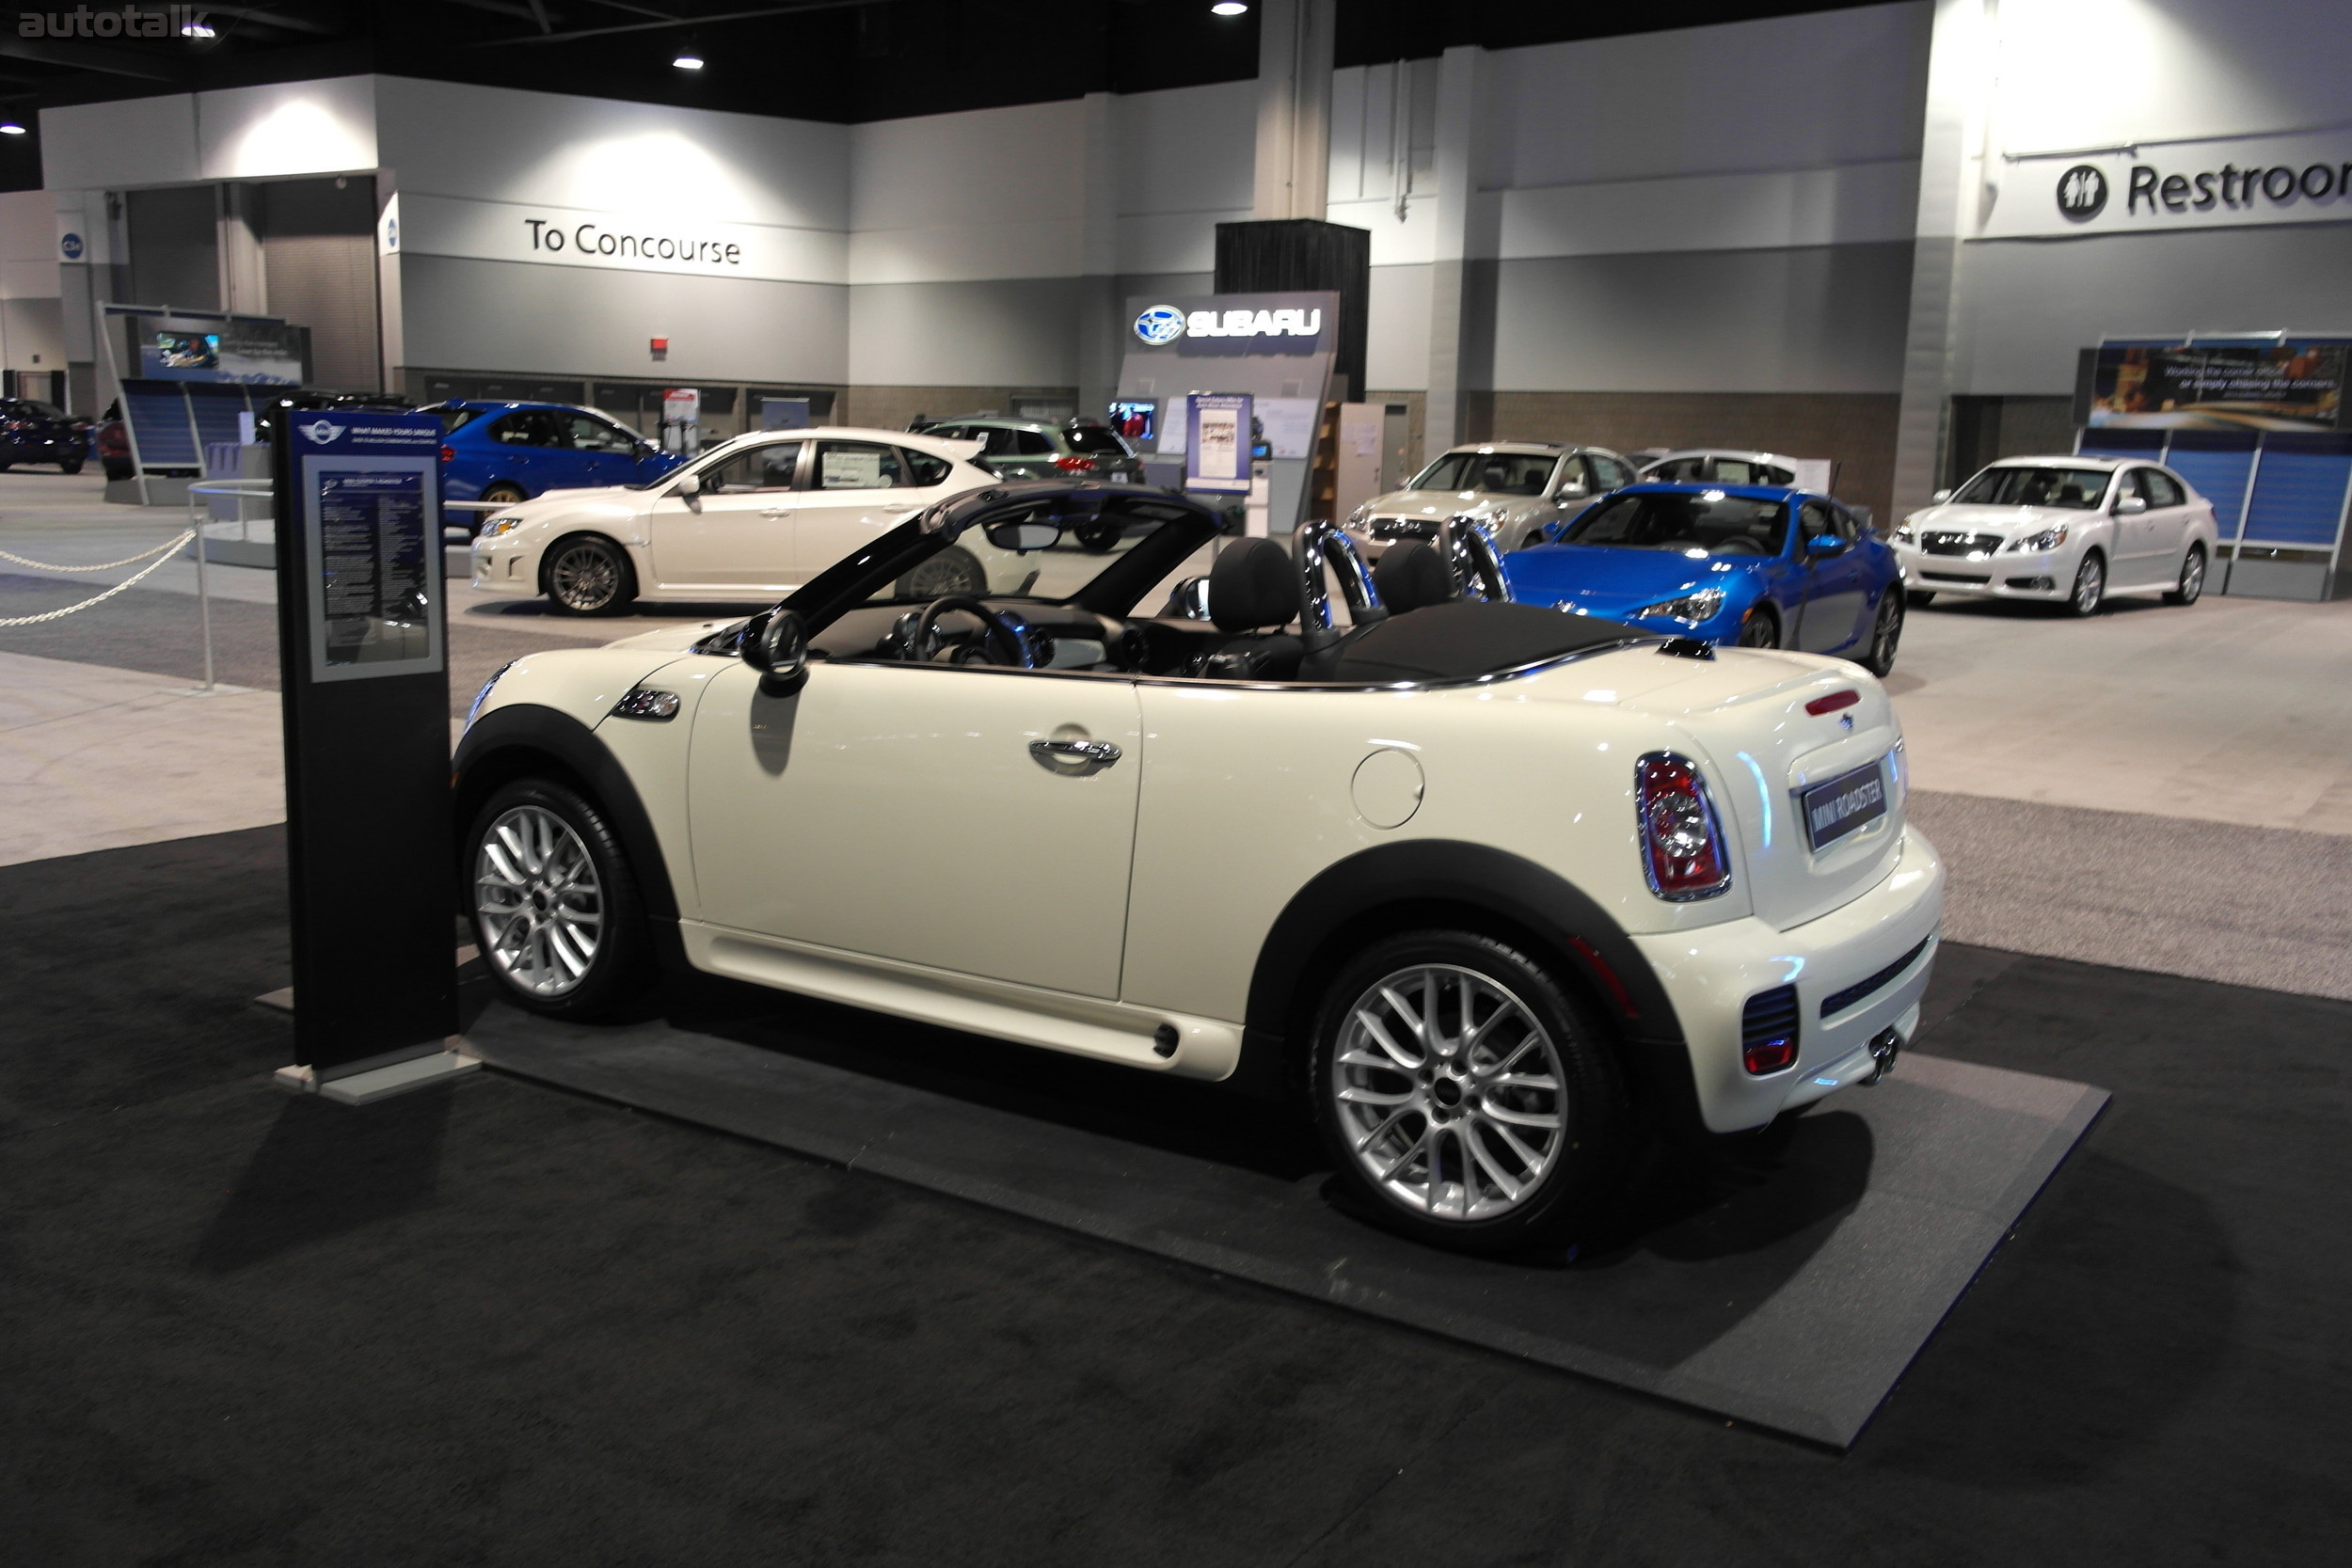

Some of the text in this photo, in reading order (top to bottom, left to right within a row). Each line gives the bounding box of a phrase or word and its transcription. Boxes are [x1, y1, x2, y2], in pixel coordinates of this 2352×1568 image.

[2128, 162, 2352, 210] Restroo
[525, 219, 740, 264] To Concourse
[1186, 309, 1321, 337] SUBARU
[1811, 778, 1883, 832] MINI ROADSTER
